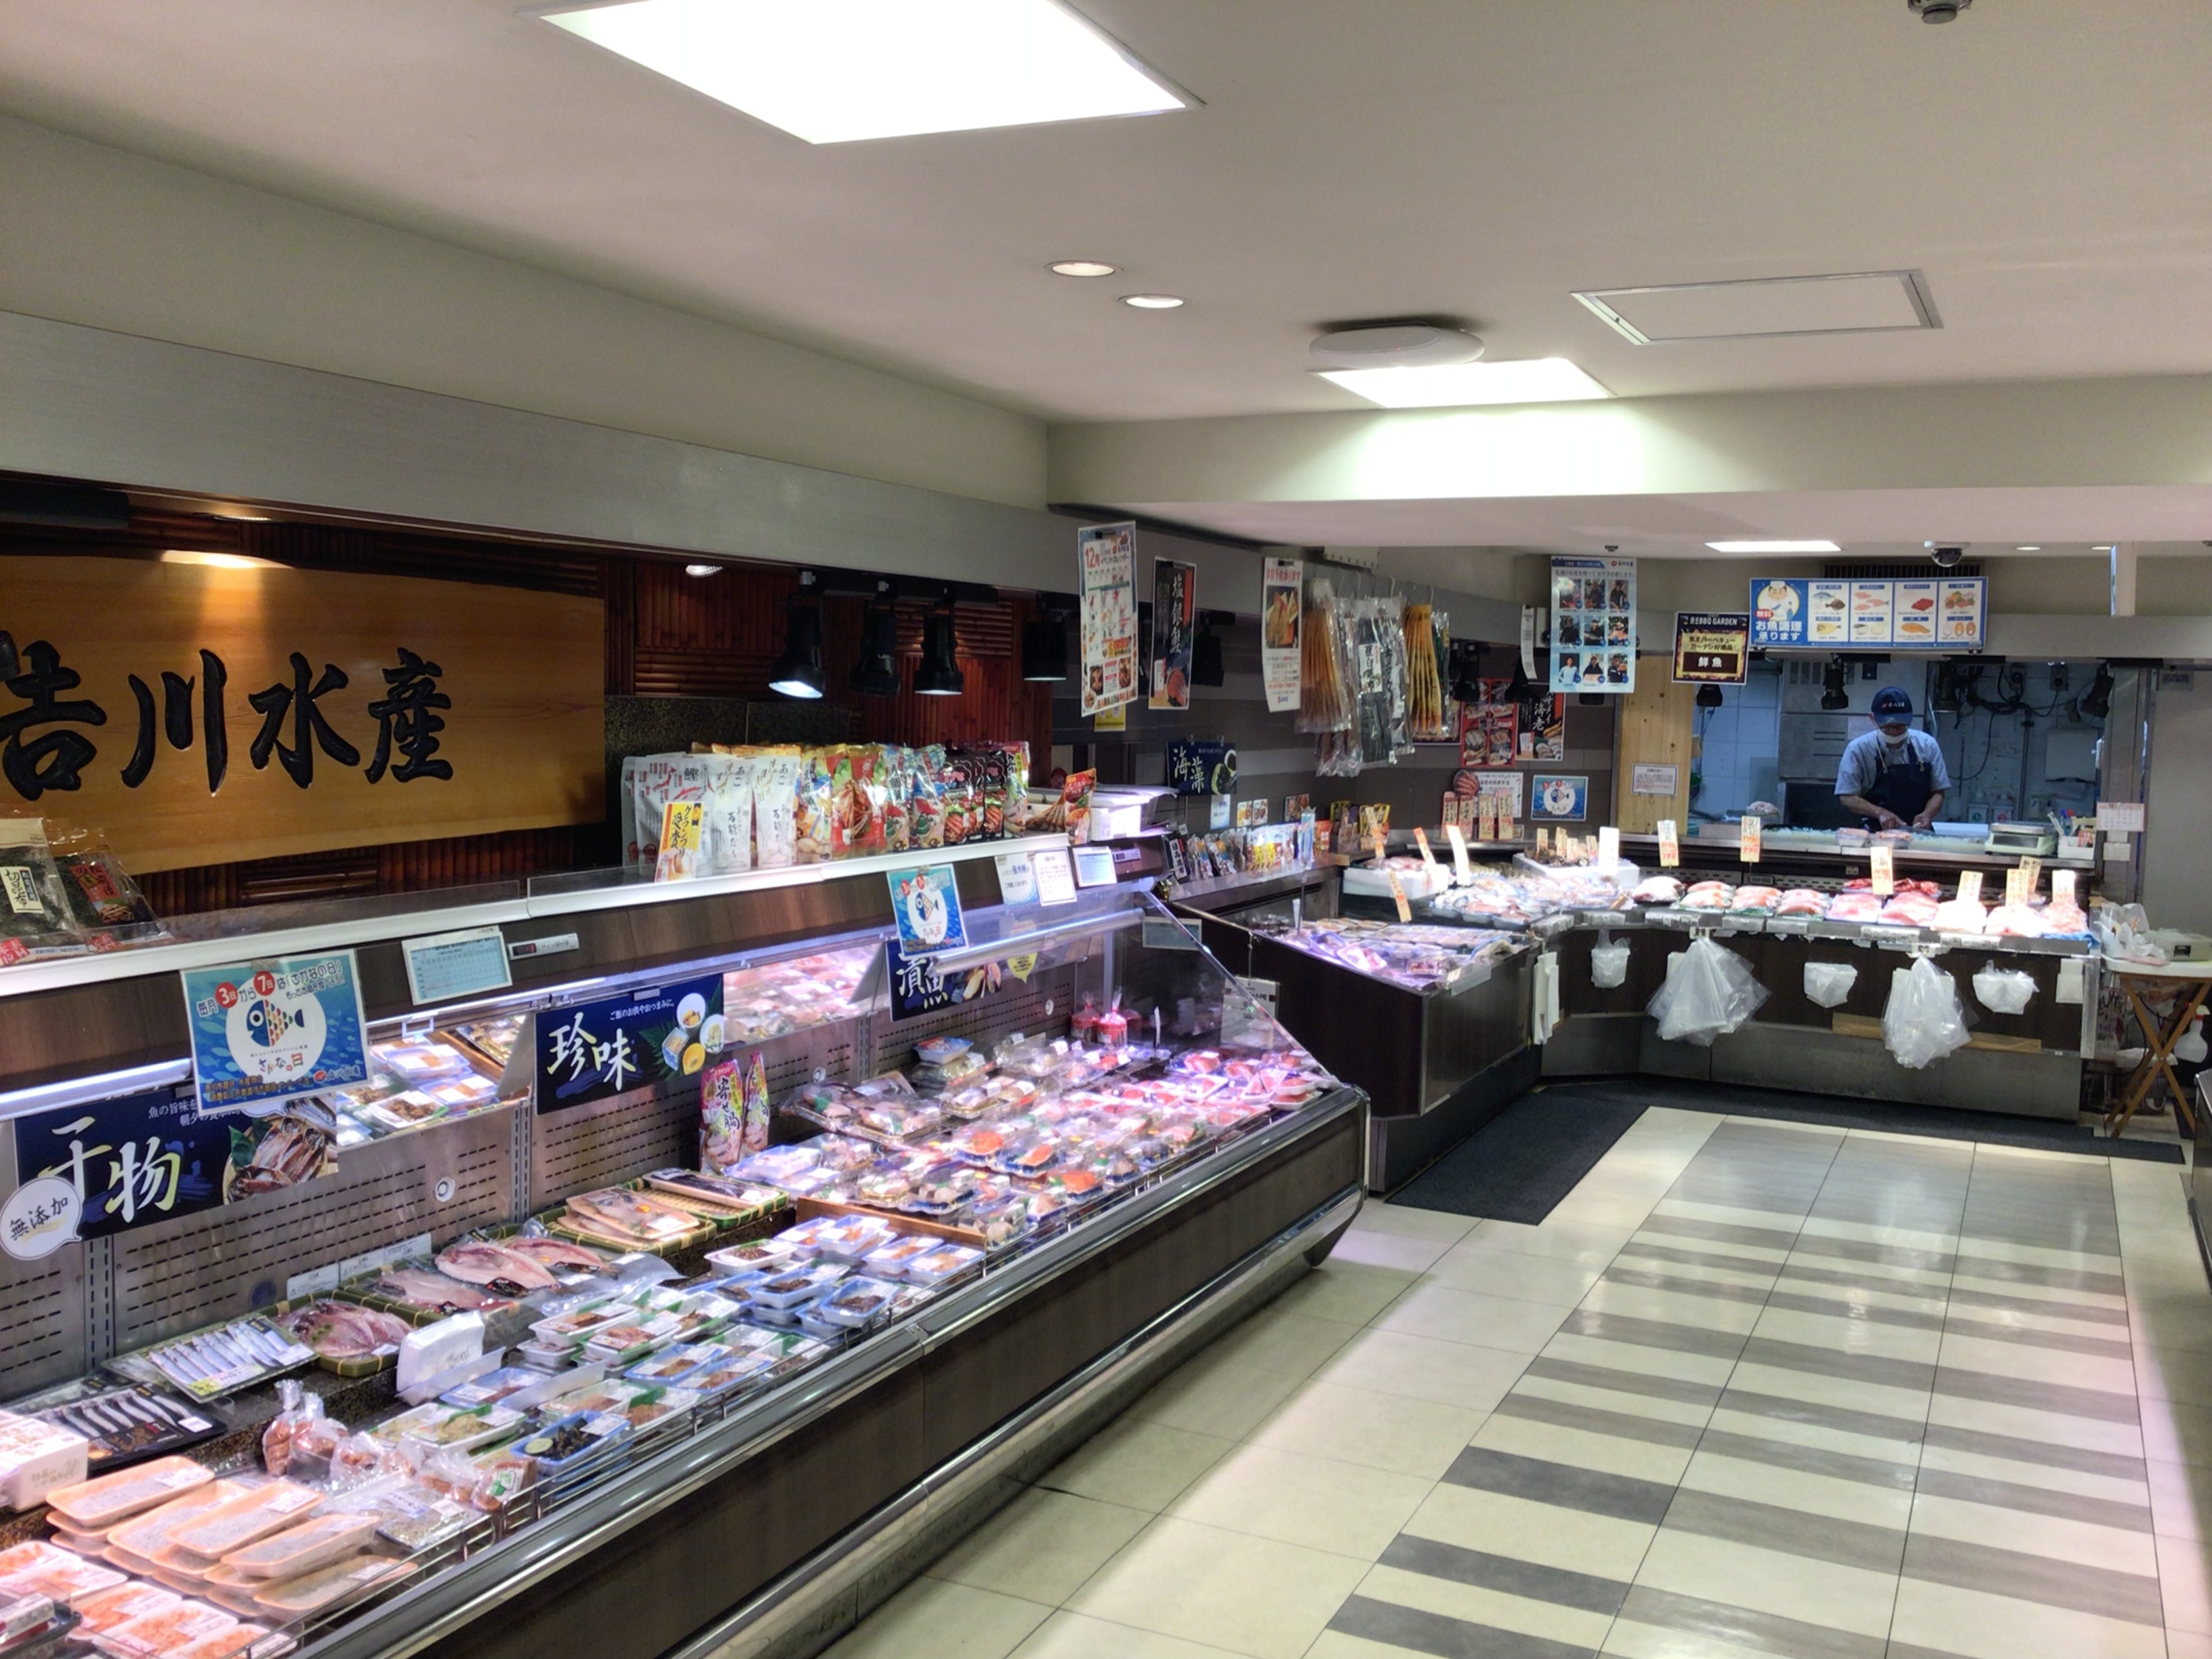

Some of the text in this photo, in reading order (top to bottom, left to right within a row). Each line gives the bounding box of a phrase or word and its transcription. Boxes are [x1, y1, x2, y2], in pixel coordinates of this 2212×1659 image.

[1086, 547, 1100, 568] 12月
[1713, 617, 1738, 626] GARDEN
[1756, 621, 1802, 632] お魚調理
[0, 640, 453, 801] 吉川水産
[1532, 703, 1546, 731] 海老
[684, 767, 699, 781] 鰹
[1173, 745, 1204, 794] 海藻
[671, 812, 682, 849] 受賞
[679, 805, 692, 858] グランプリ
[610, 999, 674, 1020] ご飯のお供やおつまみに。
[258, 1052, 304, 1075] さかなの日
[547, 1012, 636, 1092] 珍味
[716, 1077, 740, 1132] 寄せ鍋
[37, 1116, 181, 1223] 干物
[10, 1197, 68, 1241] 無添加
